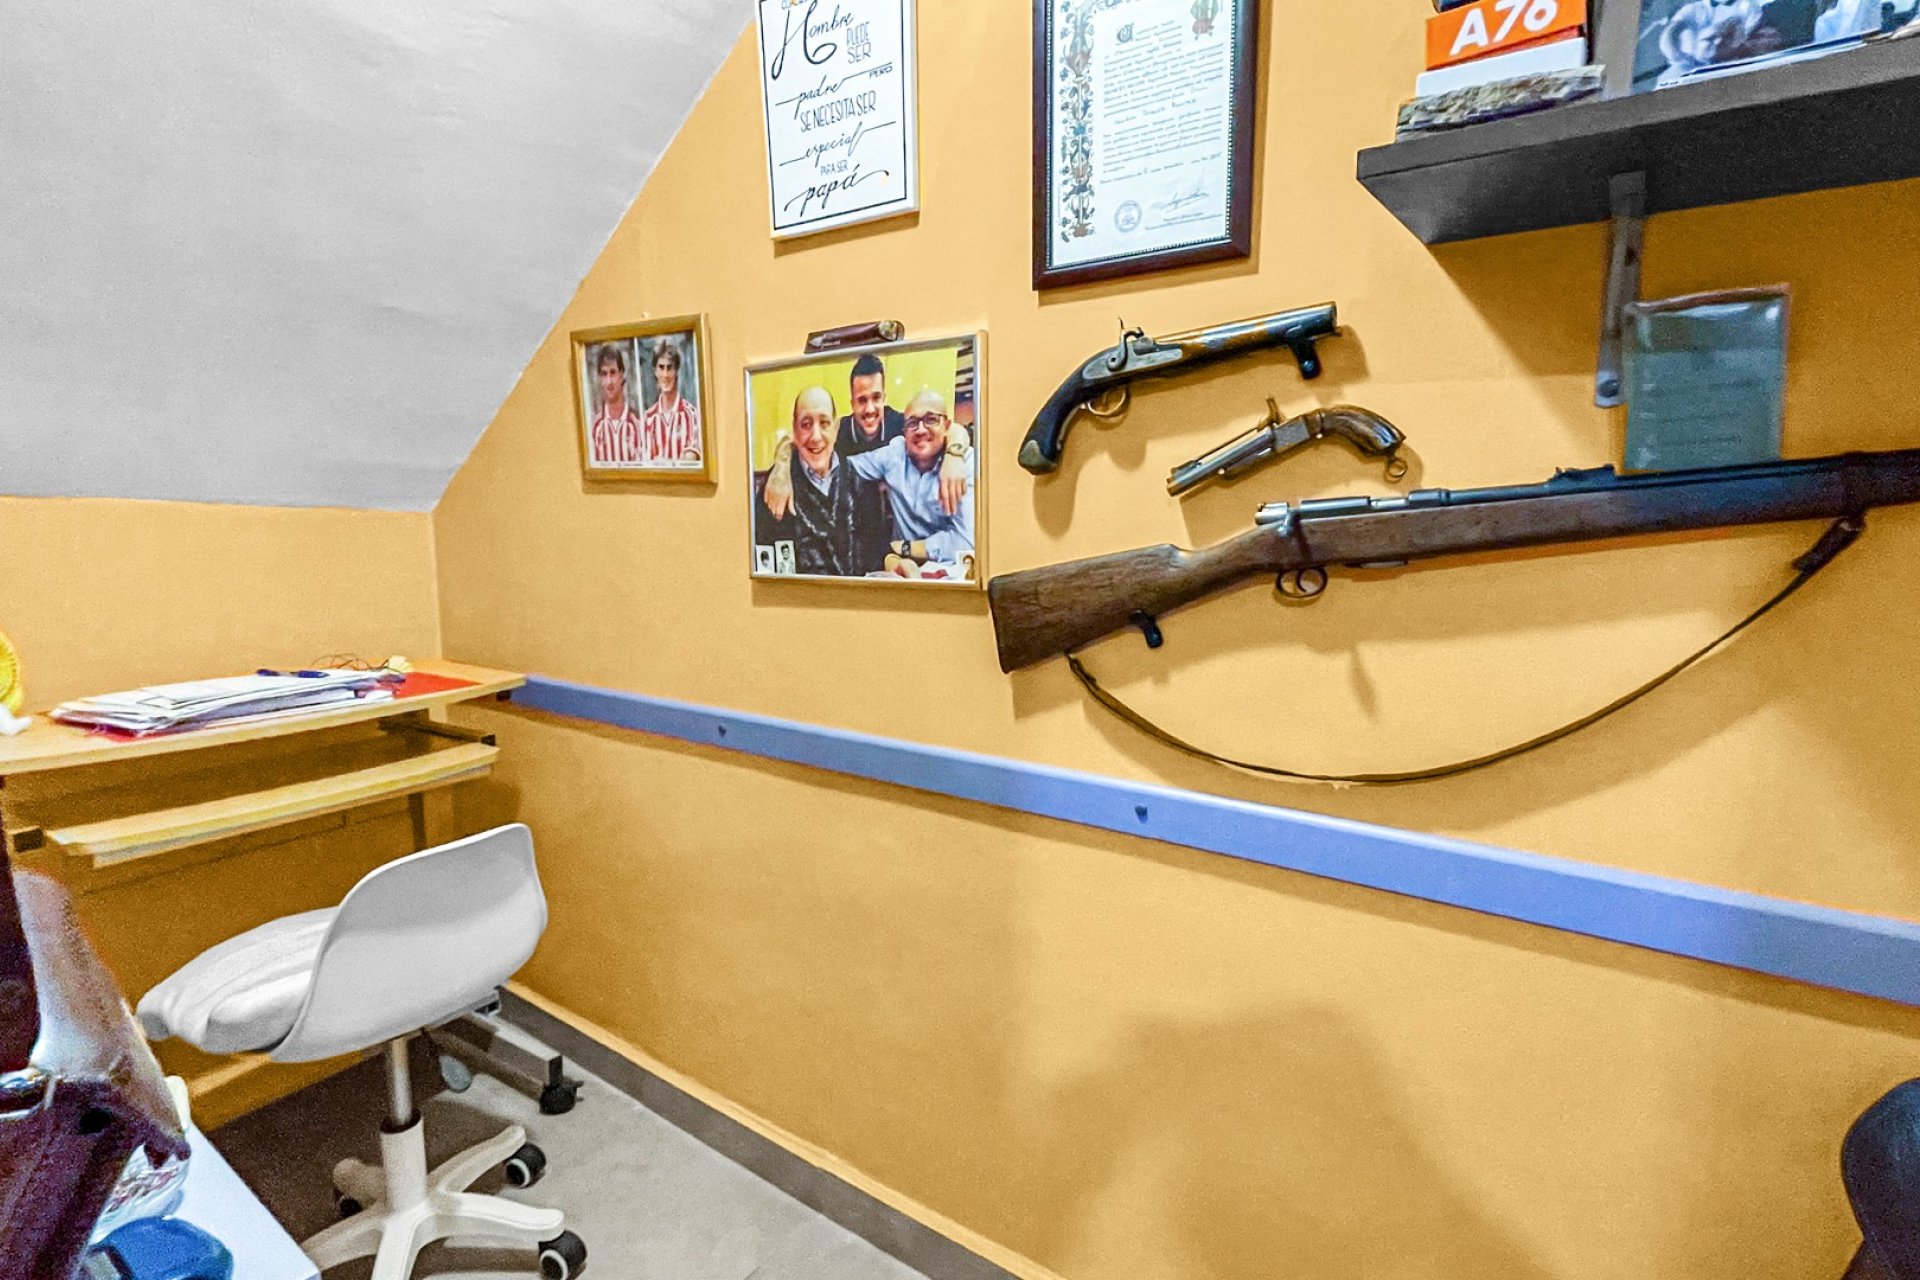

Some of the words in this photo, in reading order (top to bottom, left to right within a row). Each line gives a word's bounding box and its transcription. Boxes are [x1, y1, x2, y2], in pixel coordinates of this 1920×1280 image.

[846, 42, 872, 65] SER
[800, 110, 812, 133] SE
[813, 97, 856, 129] NECESITA
[855, 90, 876, 117] SER
[788, 121, 872, 168] especial
[791, 163, 873, 217] papá
